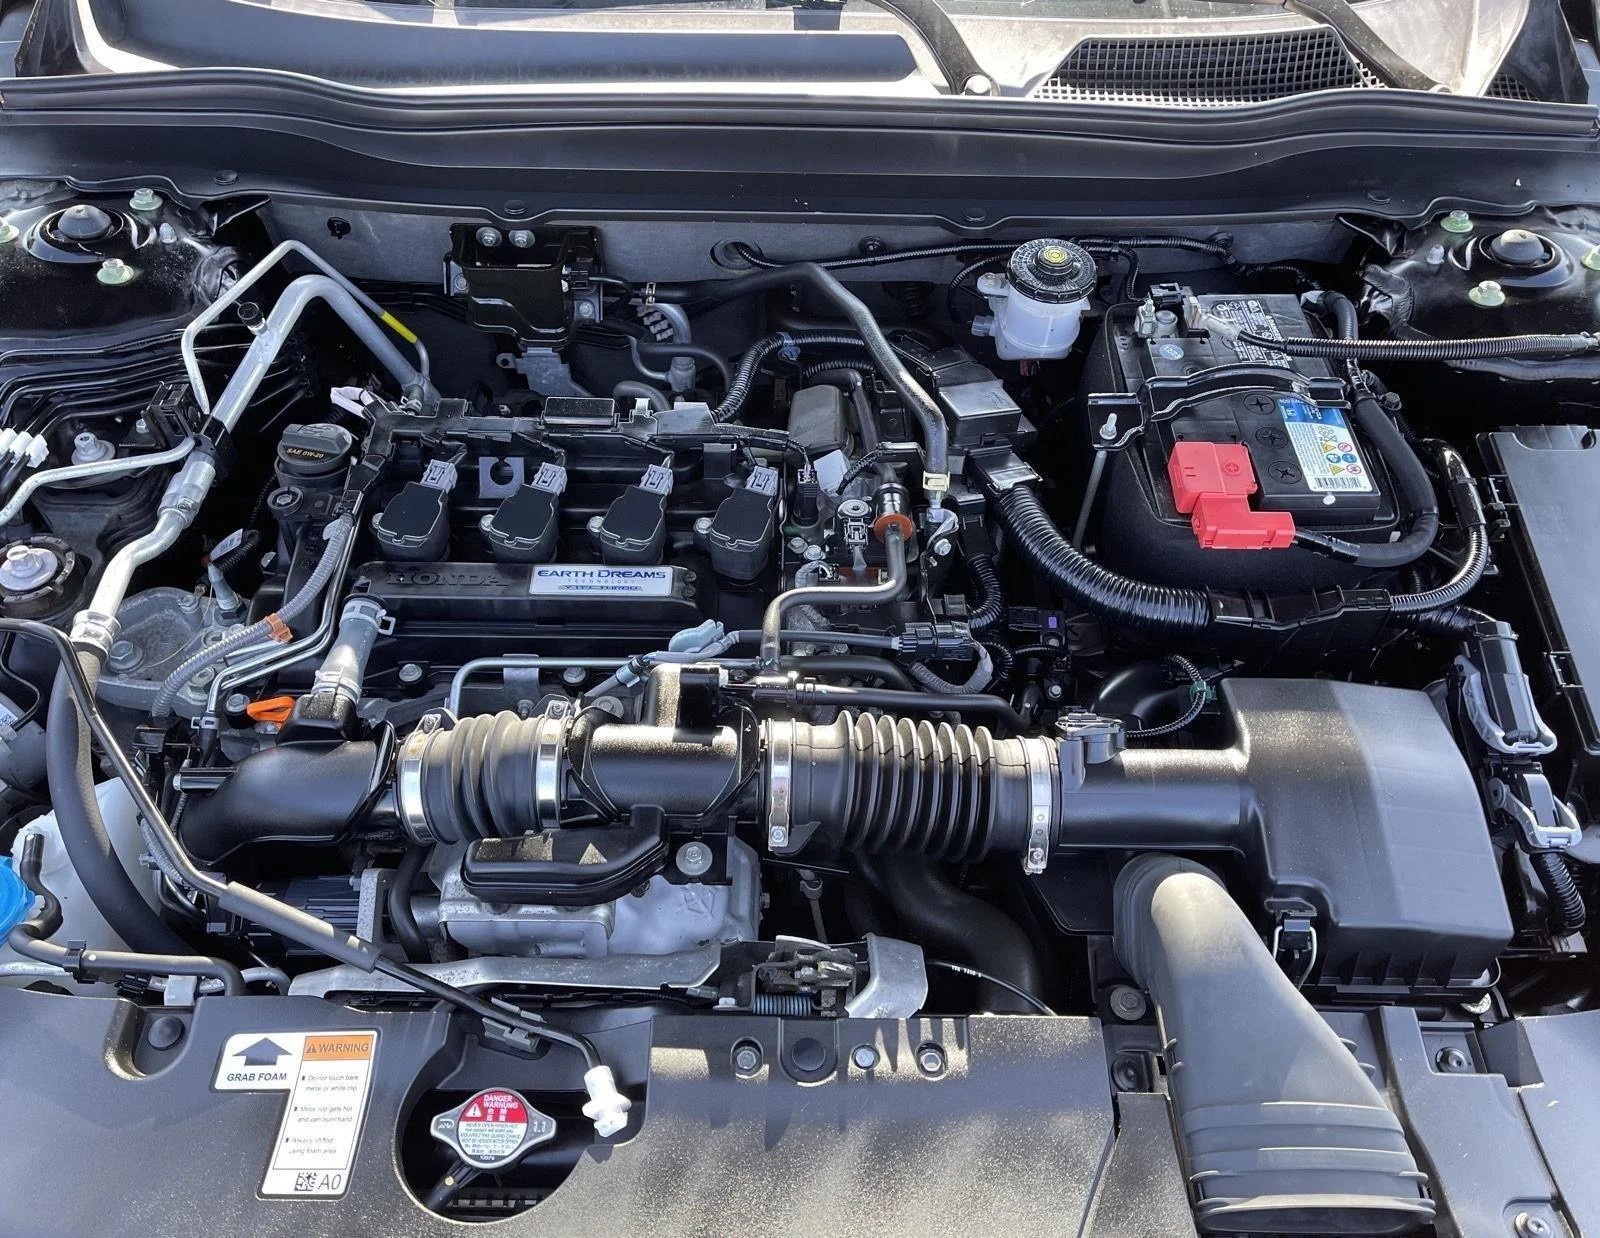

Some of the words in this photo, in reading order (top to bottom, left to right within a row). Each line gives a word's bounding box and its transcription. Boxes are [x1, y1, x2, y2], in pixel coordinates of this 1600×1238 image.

[537, 569, 593, 578] EARTH
[597, 569, 666, 578] DREAMS
[386, 571, 509, 587] HONDA
[319, 1043, 369, 1053] WARNING
[227, 1073, 255, 1082] GRAB
[258, 1072, 287, 1081] FOAM
[483, 1101, 519, 1110] WARNUNG
